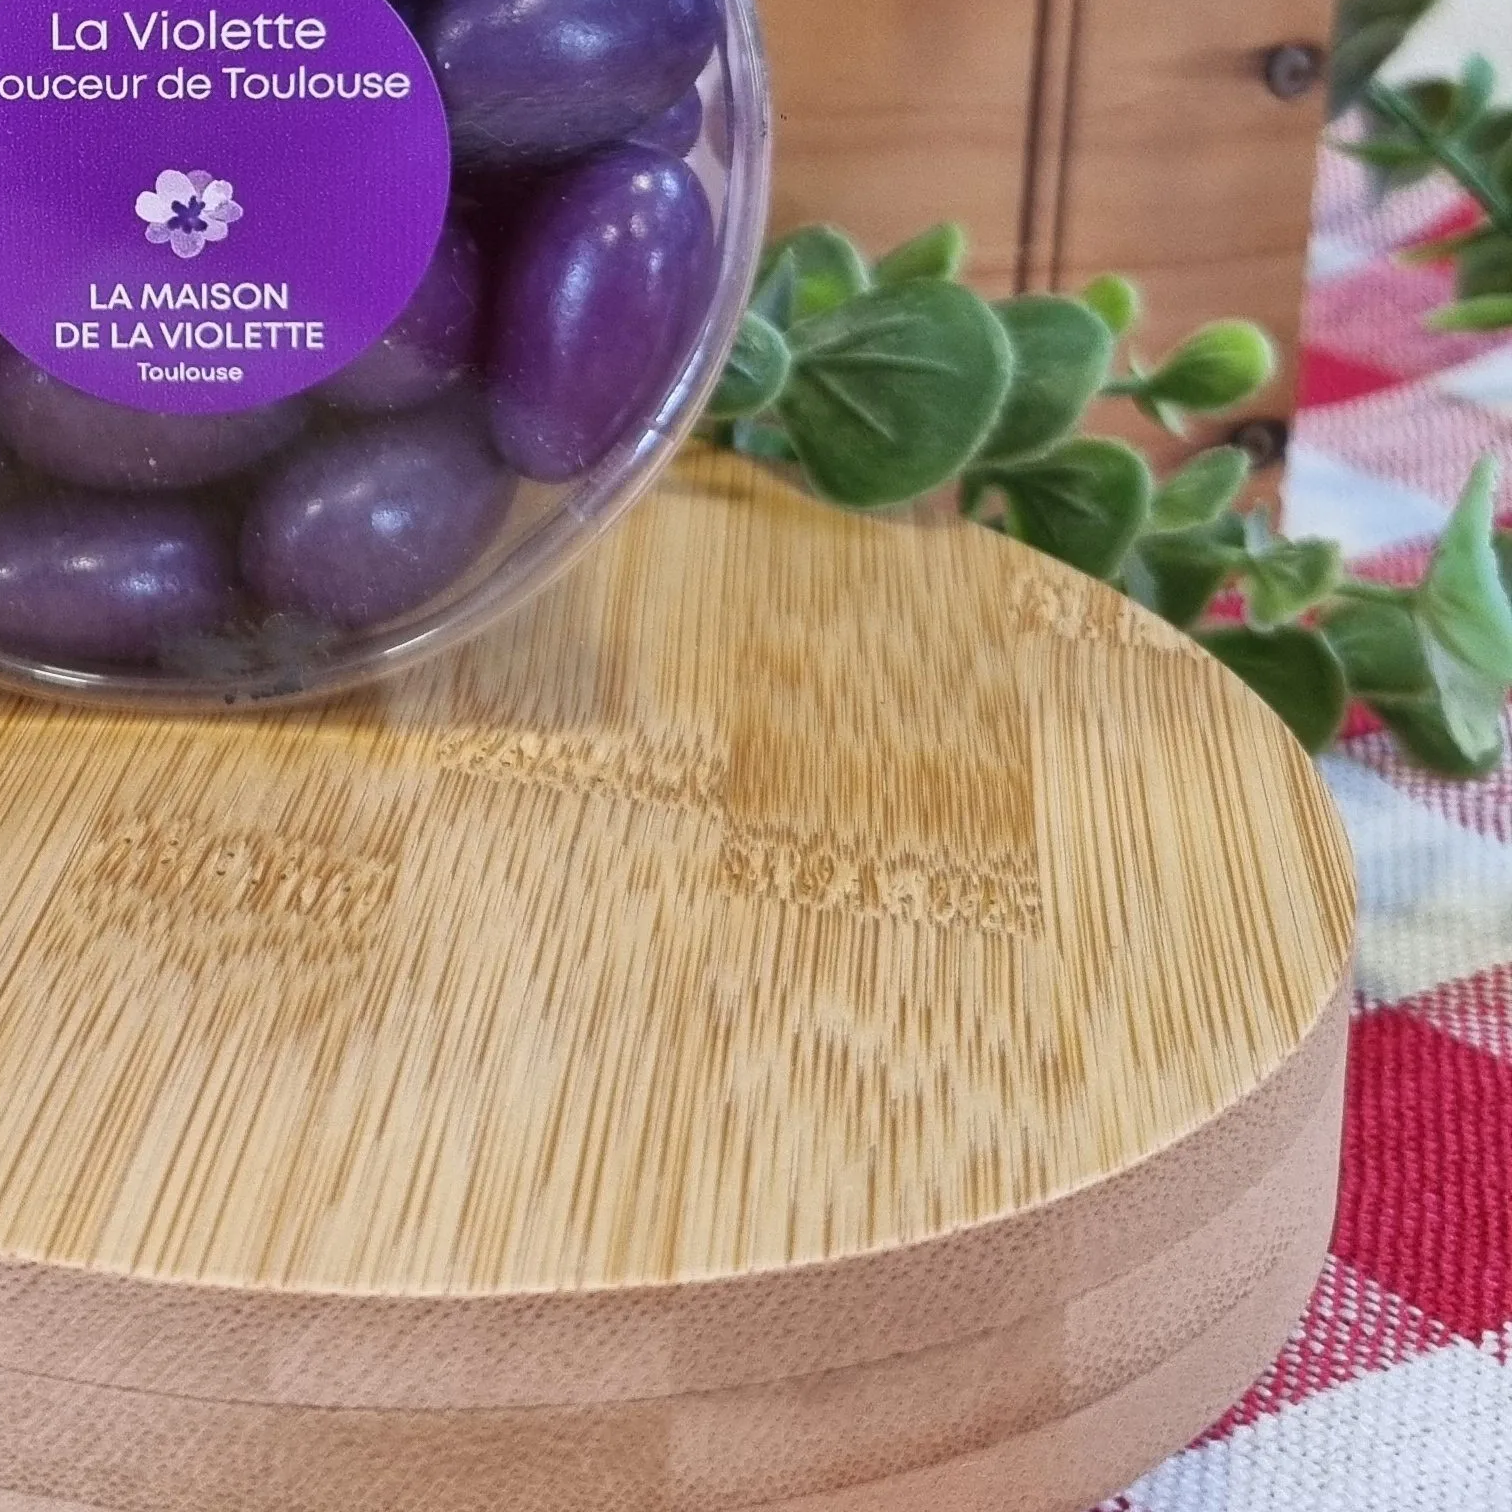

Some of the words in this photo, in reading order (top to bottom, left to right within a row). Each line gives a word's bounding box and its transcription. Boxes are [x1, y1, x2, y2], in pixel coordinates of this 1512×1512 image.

[51, 11, 108, 52] La
[123, 9, 327, 52] Violette
[157, 66, 212, 101] de
[221, 65, 411, 100] Toulouse
[90, 283, 134, 311] LA
[140, 282, 289, 312] MAISON
[55, 321, 100, 350] DE
[111, 321, 154, 350] LA
[159, 321, 326, 351] VIOLETTE
[136, 361, 244, 383] Toulouse
